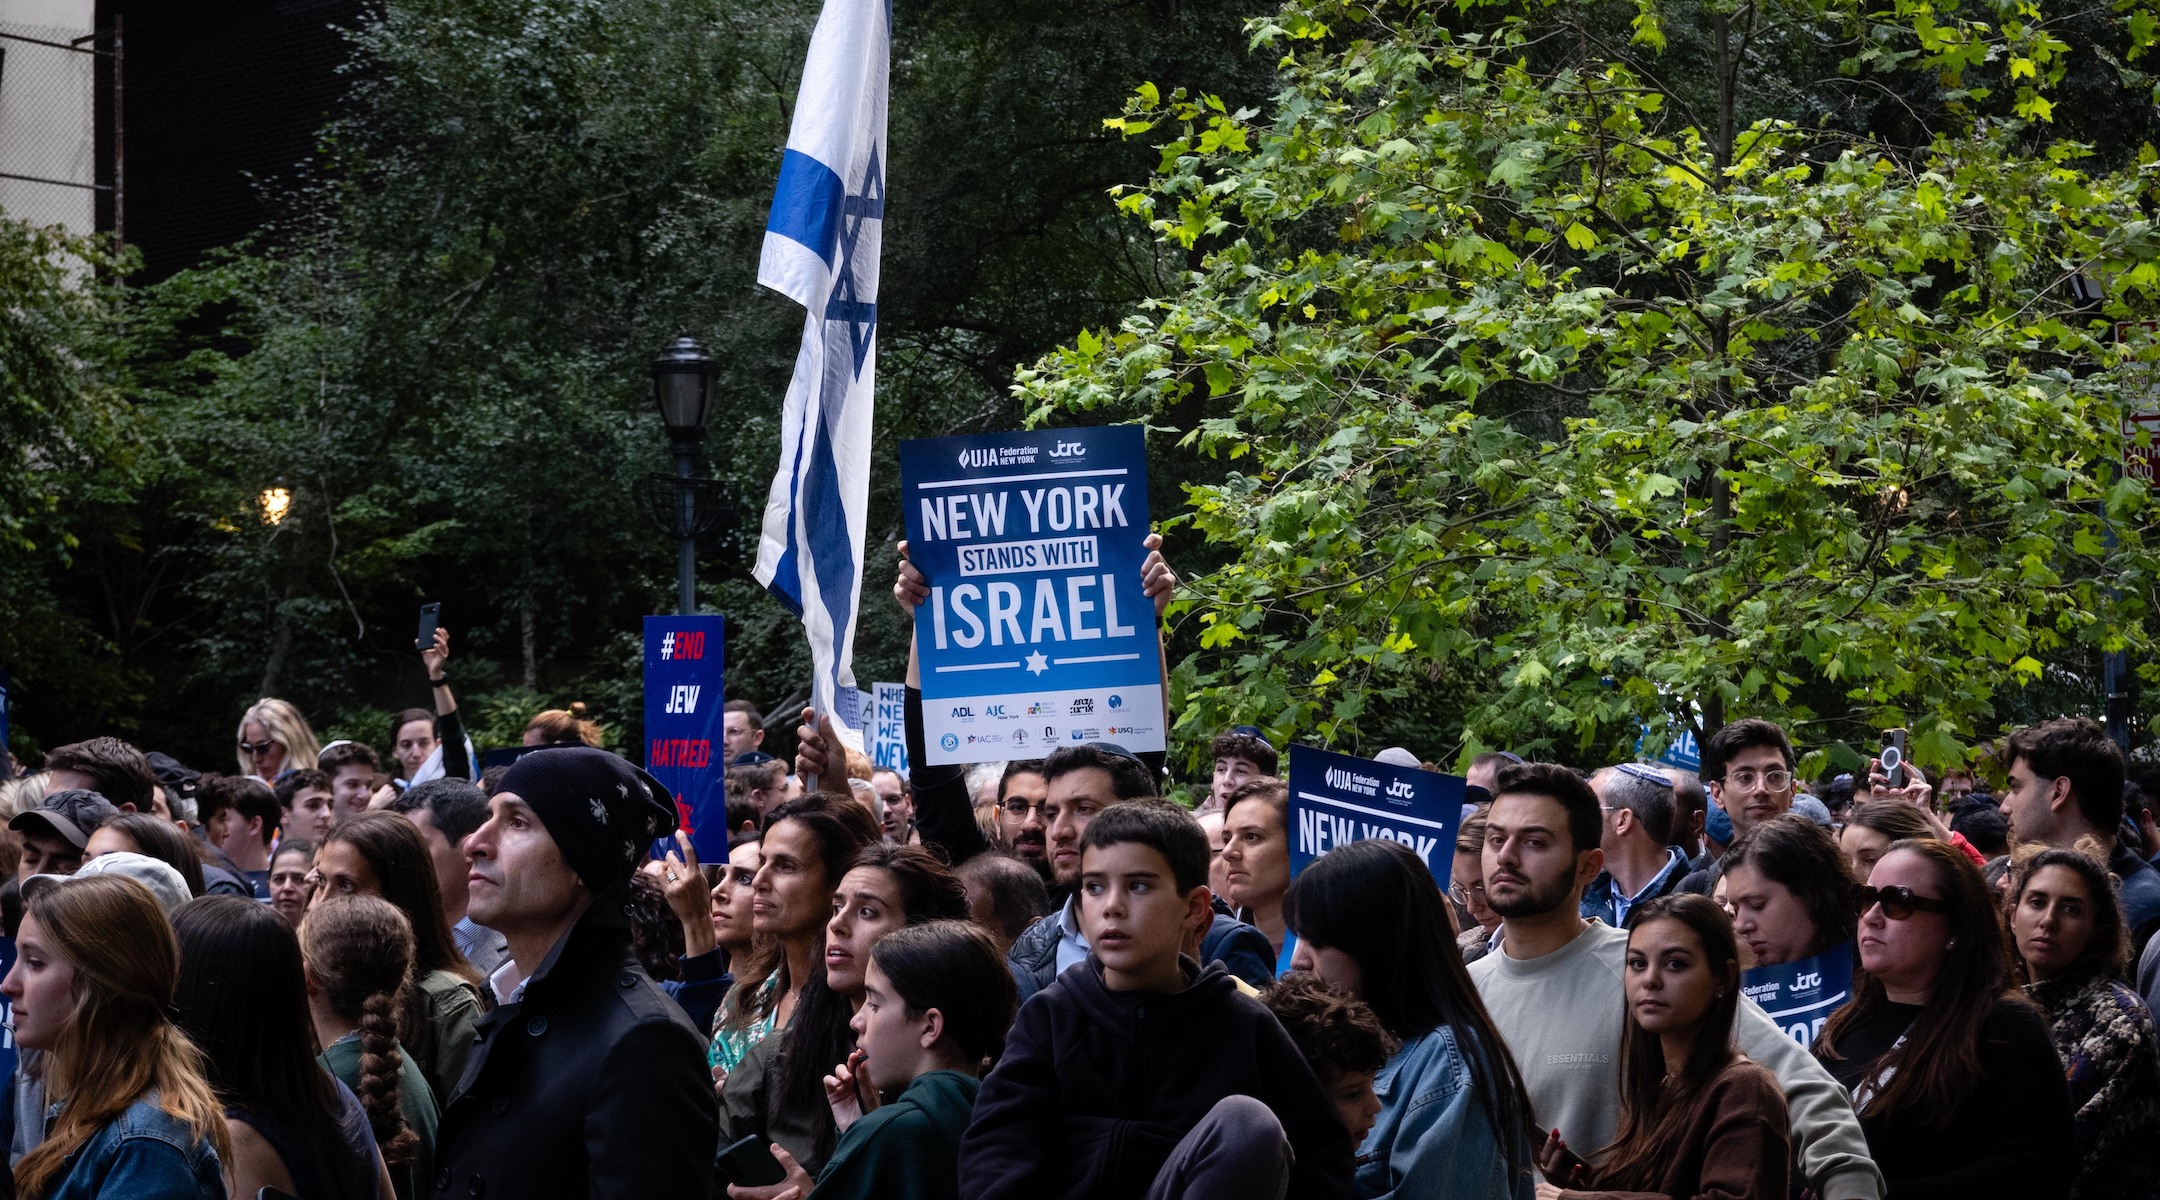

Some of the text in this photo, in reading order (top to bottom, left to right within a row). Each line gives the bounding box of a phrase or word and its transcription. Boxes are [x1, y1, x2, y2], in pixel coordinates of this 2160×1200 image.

[970, 446, 1038, 467] UJA Federation
[1000, 455, 1035, 466] NEW YORK
[921, 483, 1128, 542] NEW YORK
[963, 540, 1093, 571] STANDS WITH
[931, 573, 1136, 650] ISRAEL
[661, 632, 705, 660] #END
[665, 685, 700, 714] JEW
[951, 707, 975, 718] ADL
[986, 705, 1005, 717] AJC
[978, 735, 991, 743] IAC
[651, 739, 711, 768] HATRED
[1333, 768, 1380, 792] UJA Federation
[1352, 784, 1376, 797] NEW YORK
[1299, 807, 1355, 857] NEW
[1743, 982, 1780, 996] Federation
[1758, 992, 1777, 1002] YORK
[1547, 1053, 1610, 1065] ESSENTIALS
